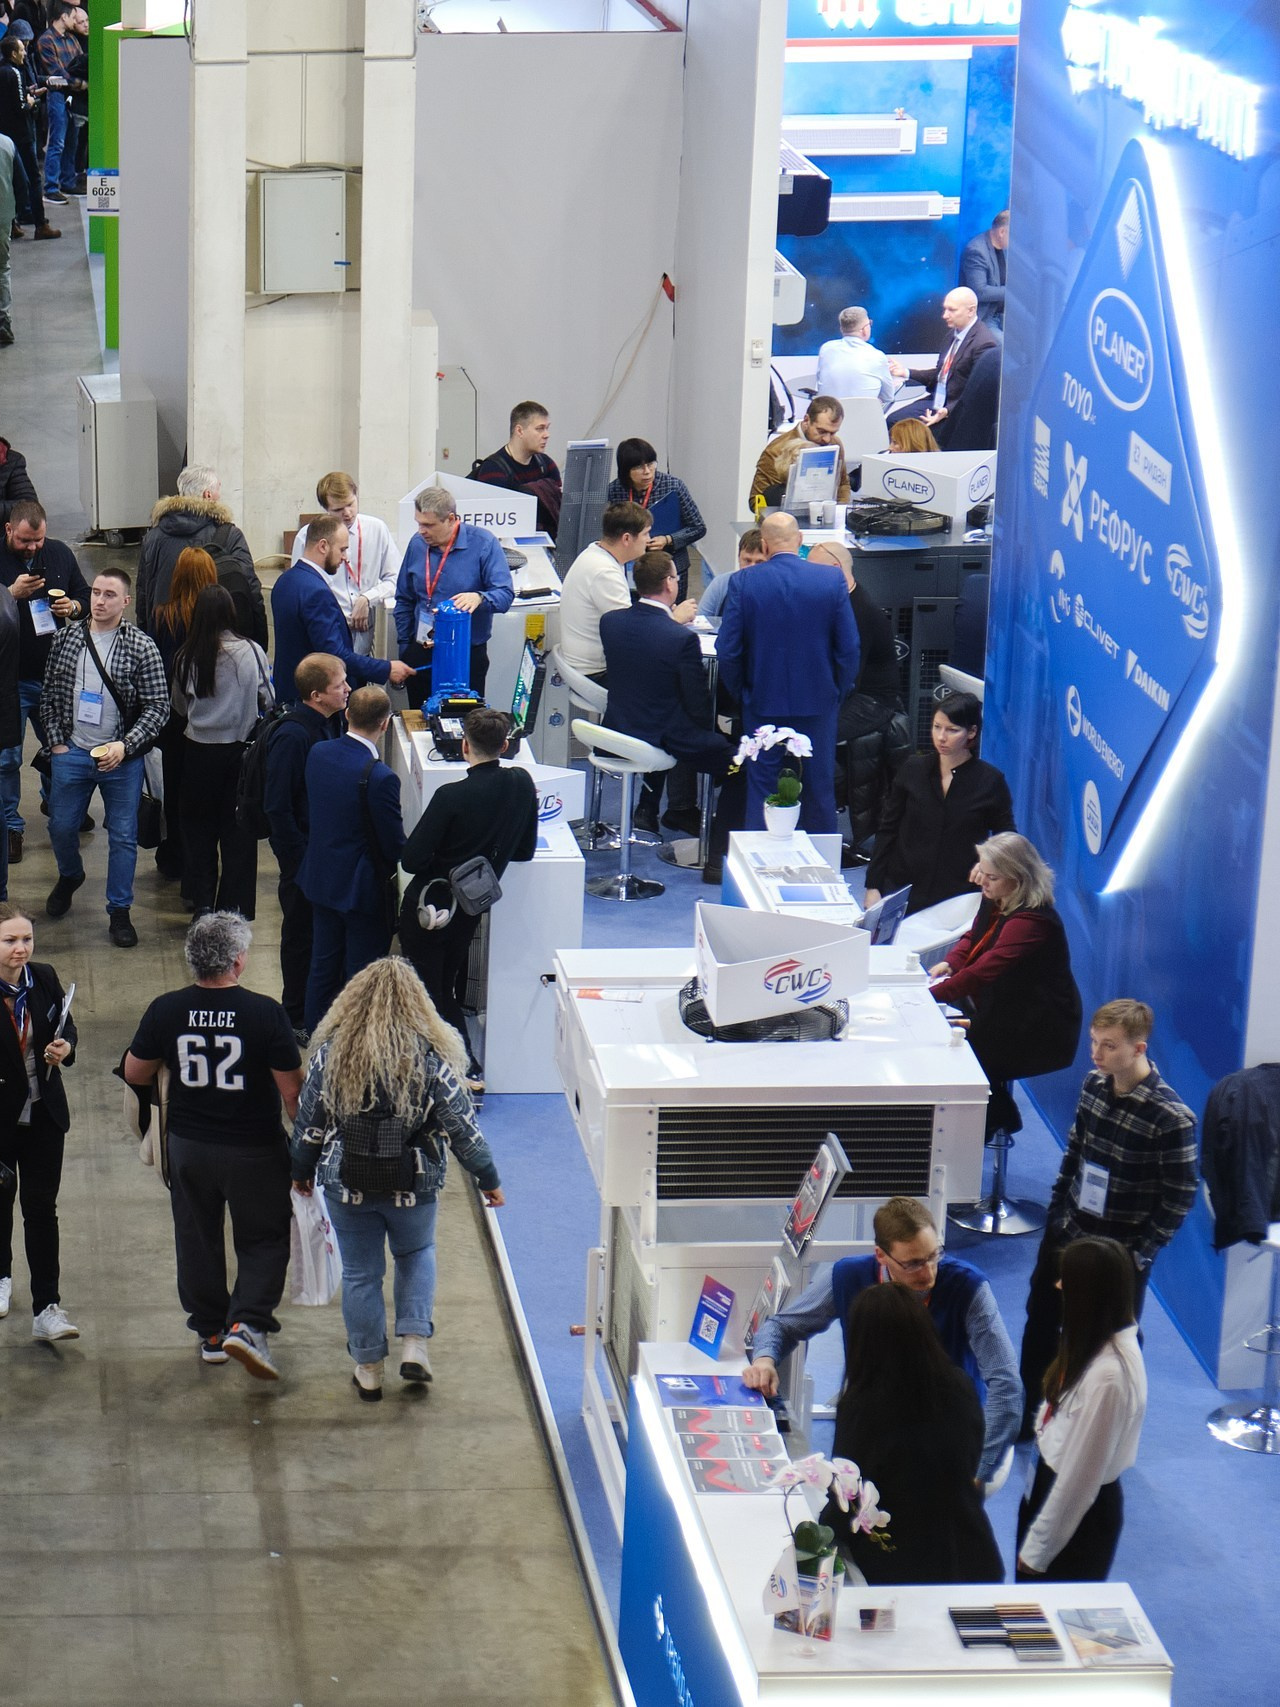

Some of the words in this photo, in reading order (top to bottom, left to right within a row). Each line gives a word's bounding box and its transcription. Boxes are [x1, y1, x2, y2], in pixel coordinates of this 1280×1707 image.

[91, 186, 116, 197] 6025
[100, 177, 108, 187] E
[1093, 314, 1146, 384] PLANER
[1062, 371, 1093, 421] TOYO
[887, 477, 929, 496] PLANER
[970, 474, 989, 493] PLANER
[1089, 489, 1153, 585] РЕФРУС
[1172, 567, 1203, 614] CWC
[1133, 663, 1170, 712] DAIKIN
[775, 967, 823, 995] CWC
[188, 1010, 236, 1028] KELCE
[177, 1034, 244, 1091] 62
